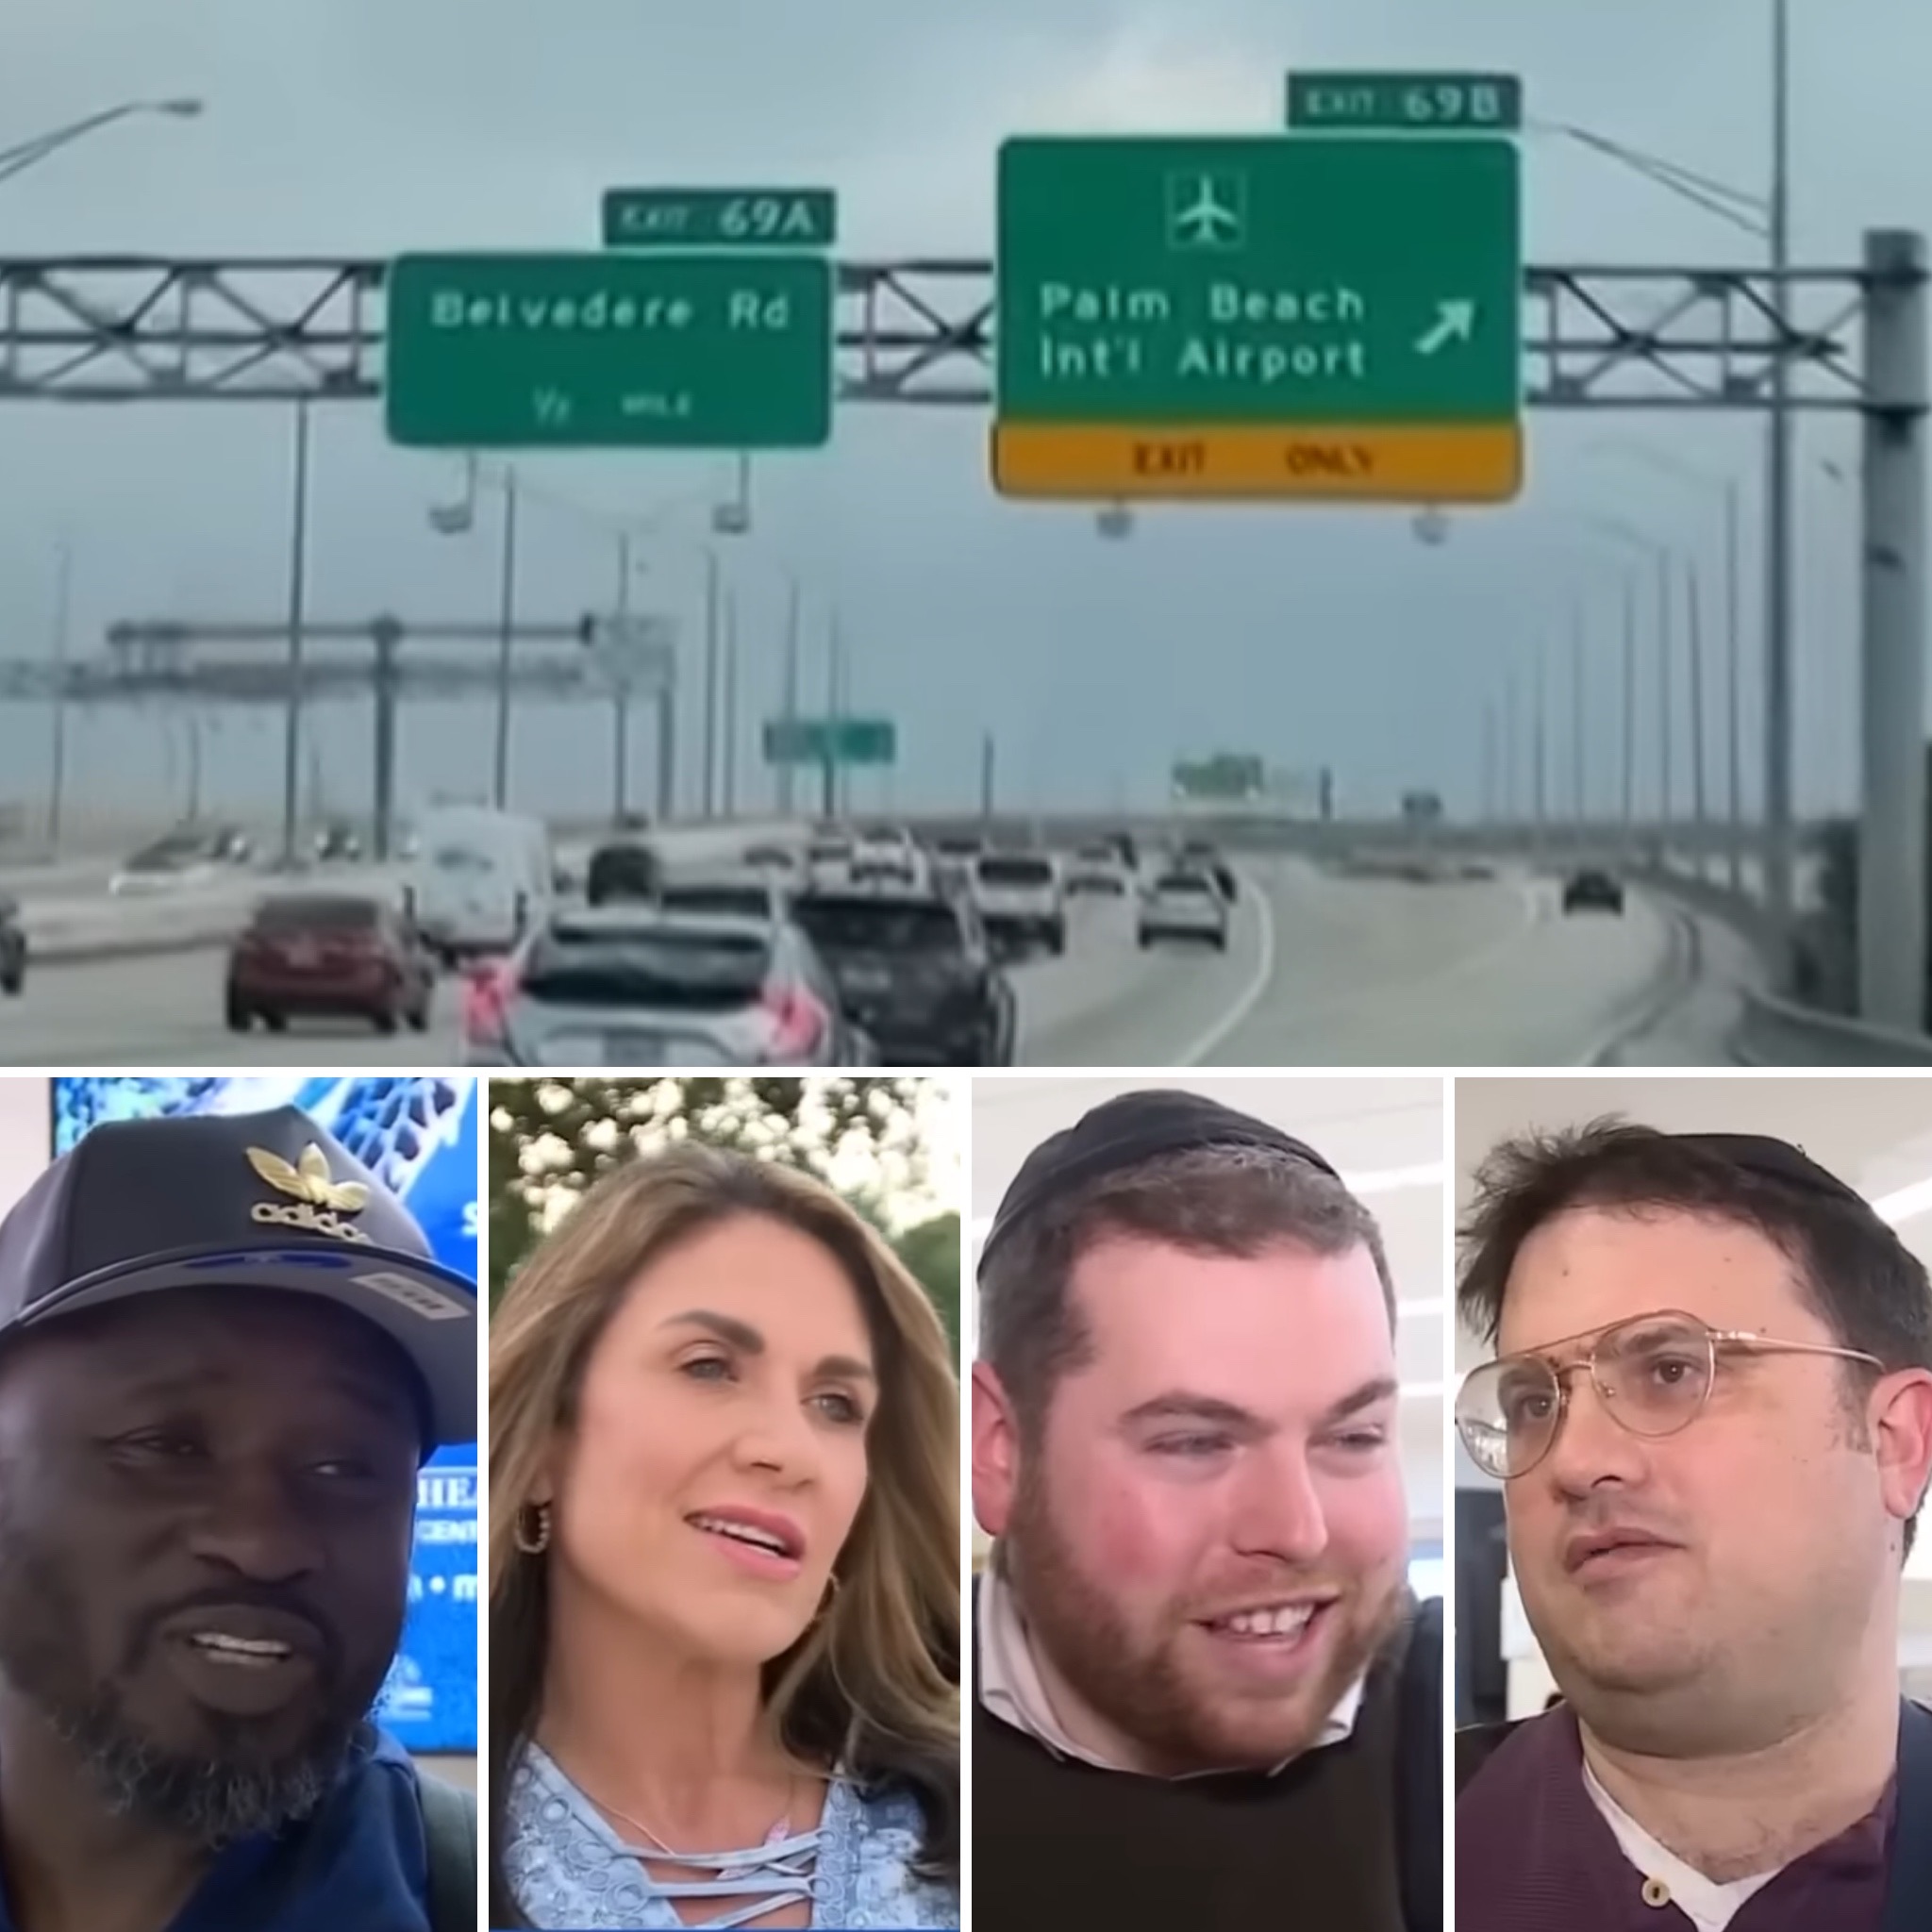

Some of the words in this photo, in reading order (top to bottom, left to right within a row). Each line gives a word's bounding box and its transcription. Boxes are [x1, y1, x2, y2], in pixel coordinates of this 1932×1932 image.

[1306, 89, 1376, 115] EXIT
[1403, 85, 1499, 121] 69B
[619, 204, 693, 233] EXIT
[719, 197, 815, 238] 69A
[429, 290, 693, 329] Belvedere
[727, 290, 791, 329] Rd
[1040, 282, 1171, 322] Palm
[1209, 282, 1366, 322] Beach
[1040, 336, 1141, 378] Int'l
[1177, 337, 1367, 382] Airport
[1133, 441, 1208, 475] EXIT
[1283, 442, 1374, 475] ONLY
